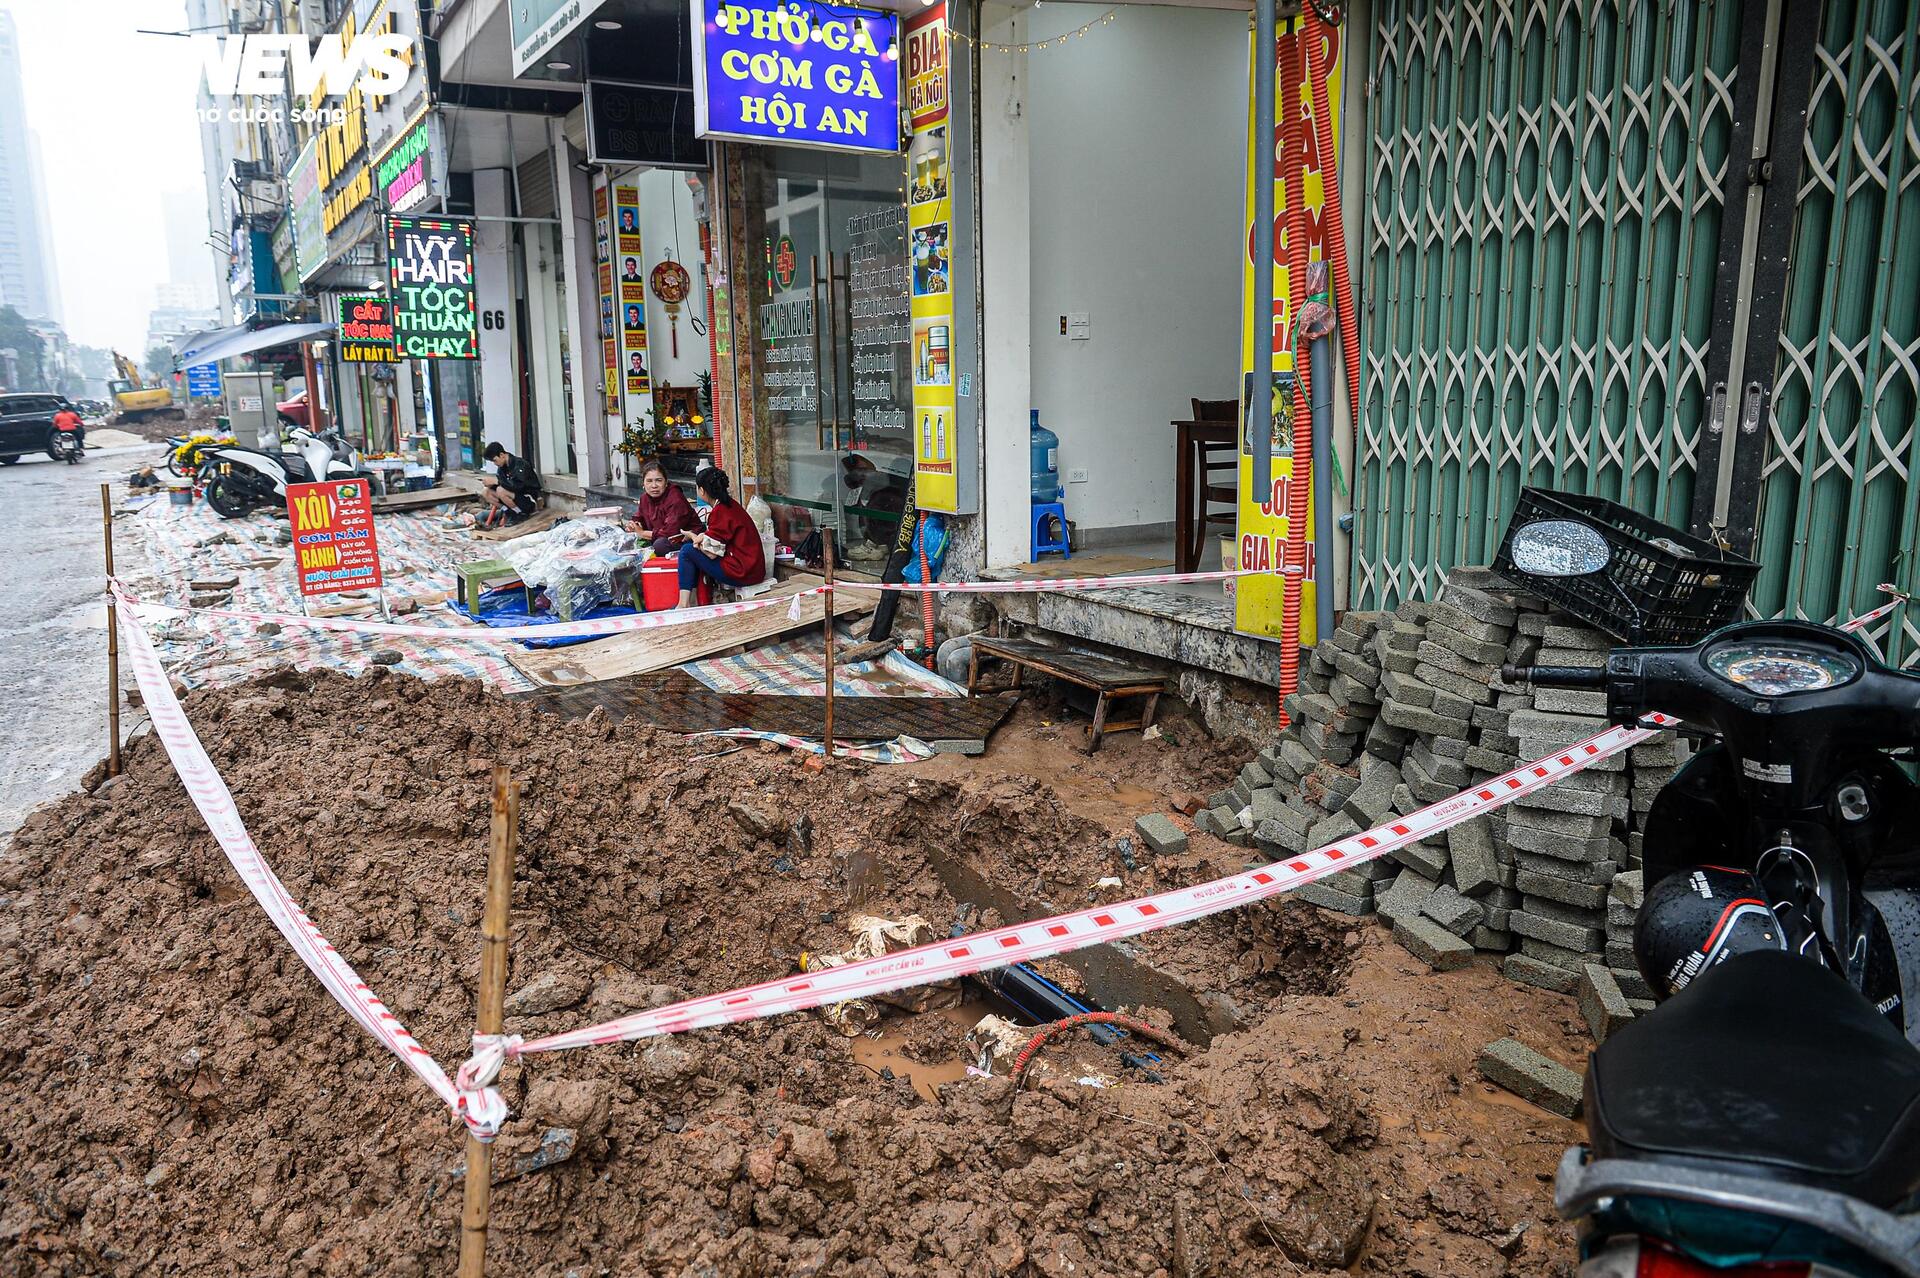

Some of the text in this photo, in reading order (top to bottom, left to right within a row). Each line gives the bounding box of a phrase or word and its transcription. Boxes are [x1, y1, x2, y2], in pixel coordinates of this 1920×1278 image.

[725, 3, 809, 44] PHỞ
[909, 26, 942, 79] BIA
[721, 50, 883, 98] CƠM GÀ
[910, 74, 943, 111] HÀ NỘI
[740, 92, 868, 136] HỘI AN
[406, 234, 458, 261] IVY
[398, 258, 468, 284] HAIR
[354, 299, 382, 320] CẮT
[402, 282, 465, 312] TÓC
[342, 320, 368, 338] TÓC
[483, 310, 505, 330] 66
[761, 303, 786, 340] KHANG
[786, 294, 814, 338] NGUYÊ
[344, 343, 362, 360] LẤY
[364, 345, 383, 361] RÁY
[406, 336, 467, 356] CHAY
[294, 488, 330, 530] XÔI
[301, 545, 337, 569] BÁNH
[1241, 534, 1270, 574] GIA
[305, 565, 374, 583] NƯỚC GIẢI KHÁT
[1668, 958, 1684, 980] HEAD
[1876, 994, 1900, 1014] NDA
